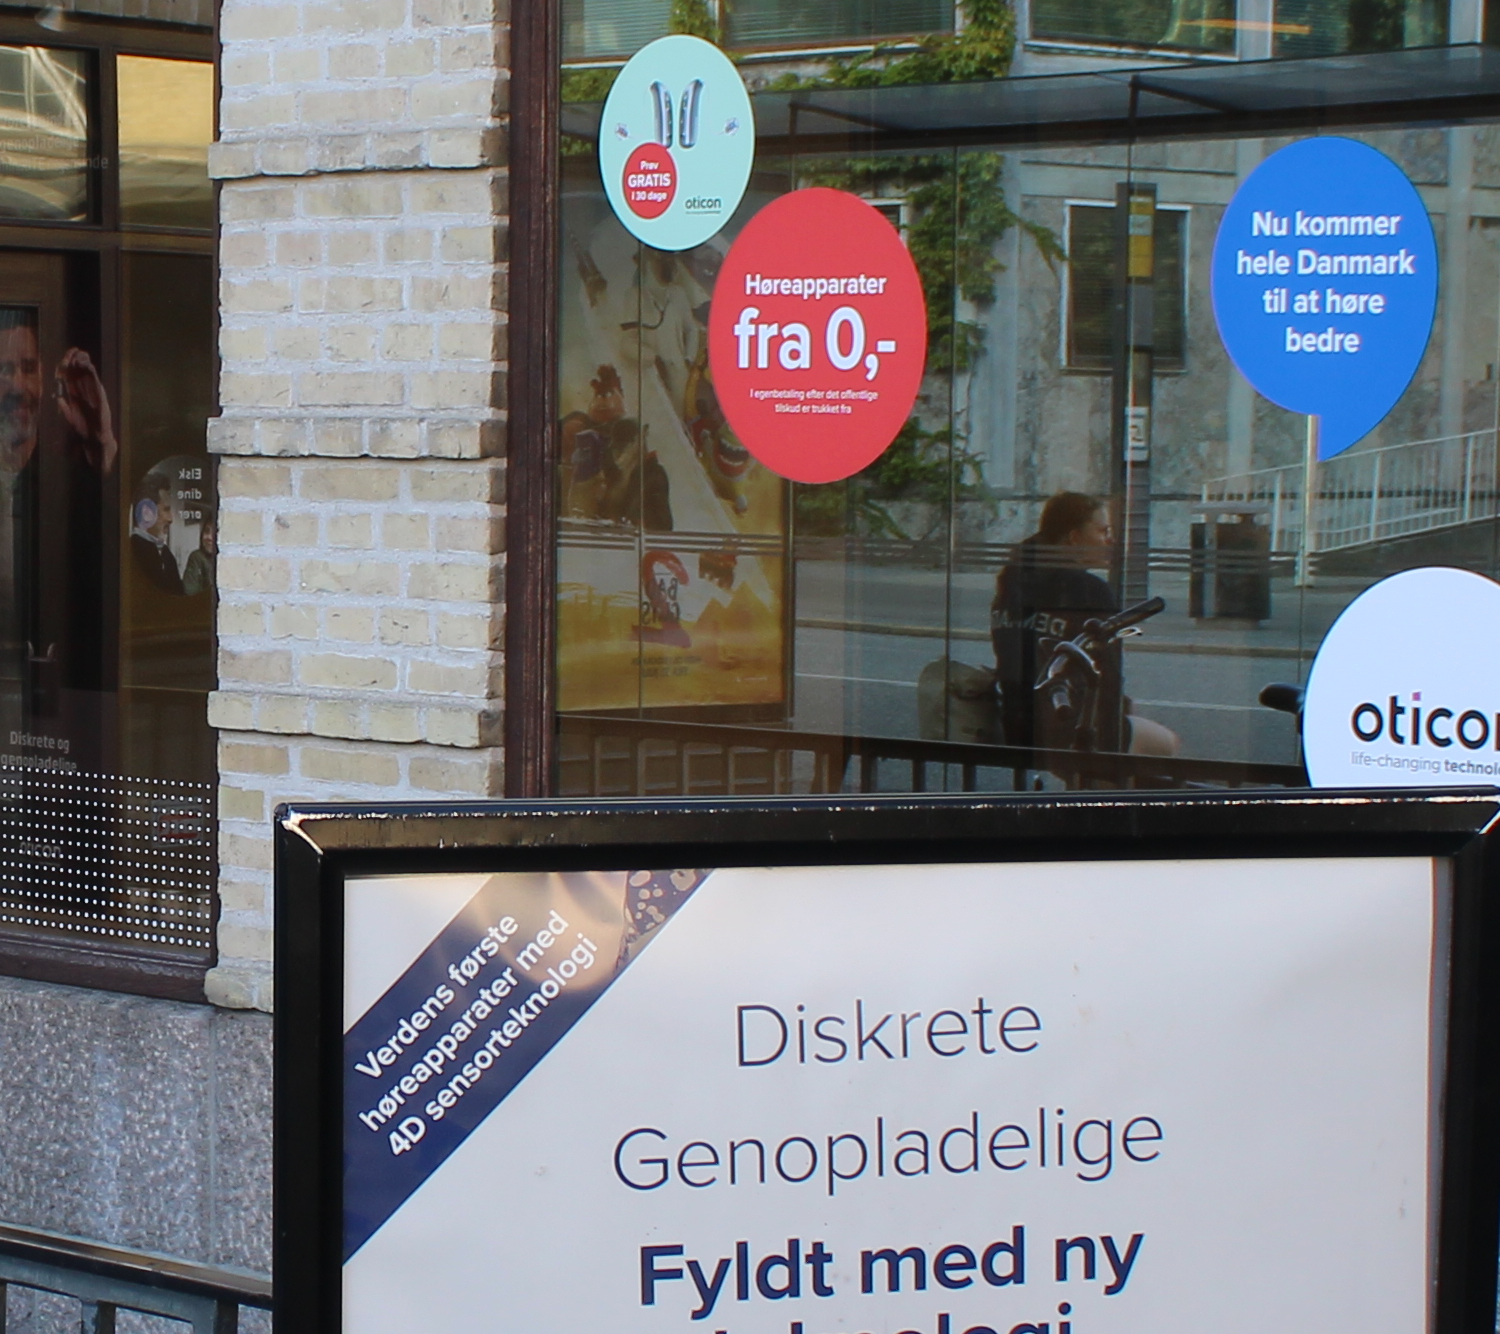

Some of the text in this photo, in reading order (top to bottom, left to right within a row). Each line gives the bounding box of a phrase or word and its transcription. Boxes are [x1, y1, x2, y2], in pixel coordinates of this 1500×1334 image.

[628, 173, 671, 188] GRATIS
[636, 191, 646, 201] 30
[647, 191, 667, 203] dage
[685, 196, 722, 209] oticon
[1252, 210, 1401, 236] Nu kommer
[1236, 248, 1416, 275] hele Danmark
[745, 273, 888, 300] Høreapparater
[1262, 288, 1385, 315] til at høre
[734, 306, 896, 381] fra 0,-
[1285, 326, 1361, 353] bedre
[825, 389, 840, 399] det
[840, 404, 852, 414] fra
[10, 730, 70, 754] Diskrete og
[1351, 751, 1441, 773] life-changing
[355, 915, 519, 1079] Verdens første
[359, 910, 570, 1131] høreapparater med
[736, 996, 1042, 1067] Diskrete
[388, 932, 598, 1157] 4D sensorteknologi
[613, 1106, 1163, 1197] Genopladelige
[639, 1224, 1145, 1321] Fyldt med ny
